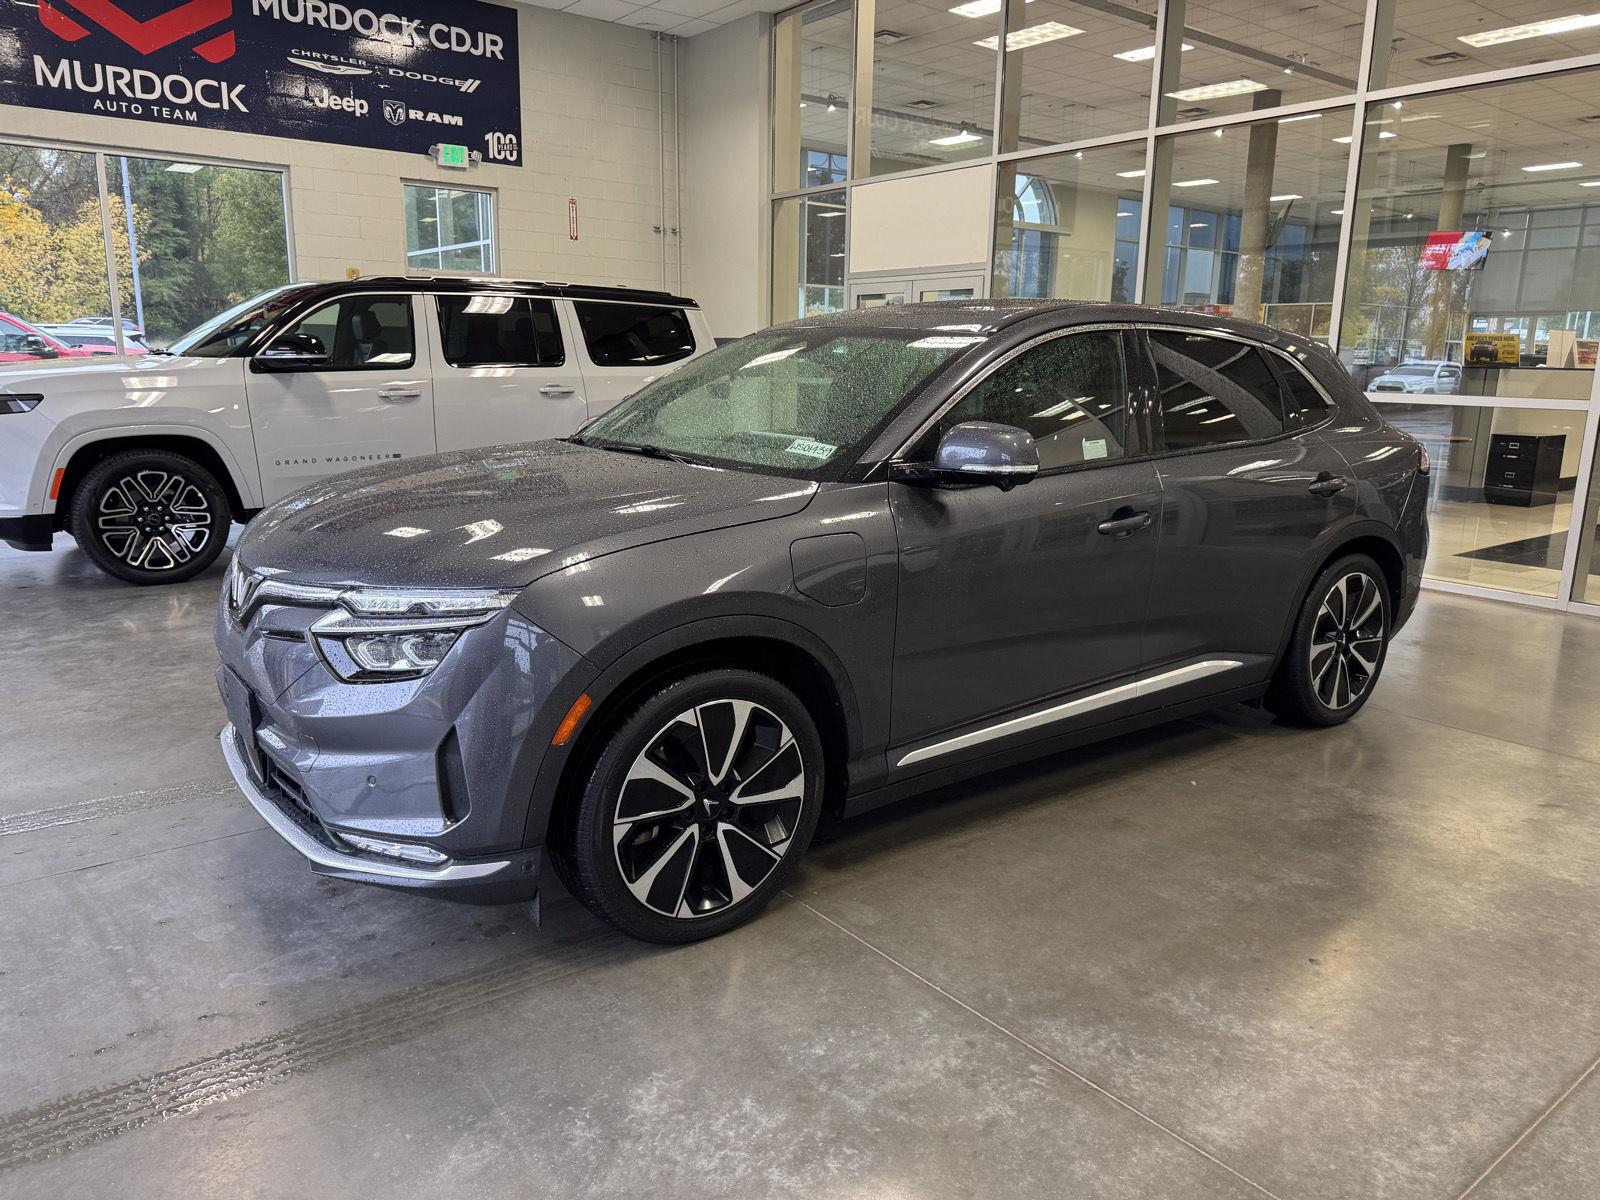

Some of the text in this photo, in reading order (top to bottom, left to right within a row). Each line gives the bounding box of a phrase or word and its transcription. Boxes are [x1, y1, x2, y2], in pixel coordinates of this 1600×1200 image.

[251, 0, 504, 60] MURDOCK CDJR
[291, 48, 367, 68] CHRYSLER
[33, 54, 249, 113] MURDOCK
[388, 68, 467, 89] DODGE
[93, 98, 198, 122] AUTO TEAM
[314, 89, 369, 117] Jeep
[408, 108, 463, 126] RAM
[443, 144, 466, 164] EXIT
[484, 131, 518, 162] 100
[275, 457, 317, 466] GRAND
[325, 453, 390, 463] WAGONEER
